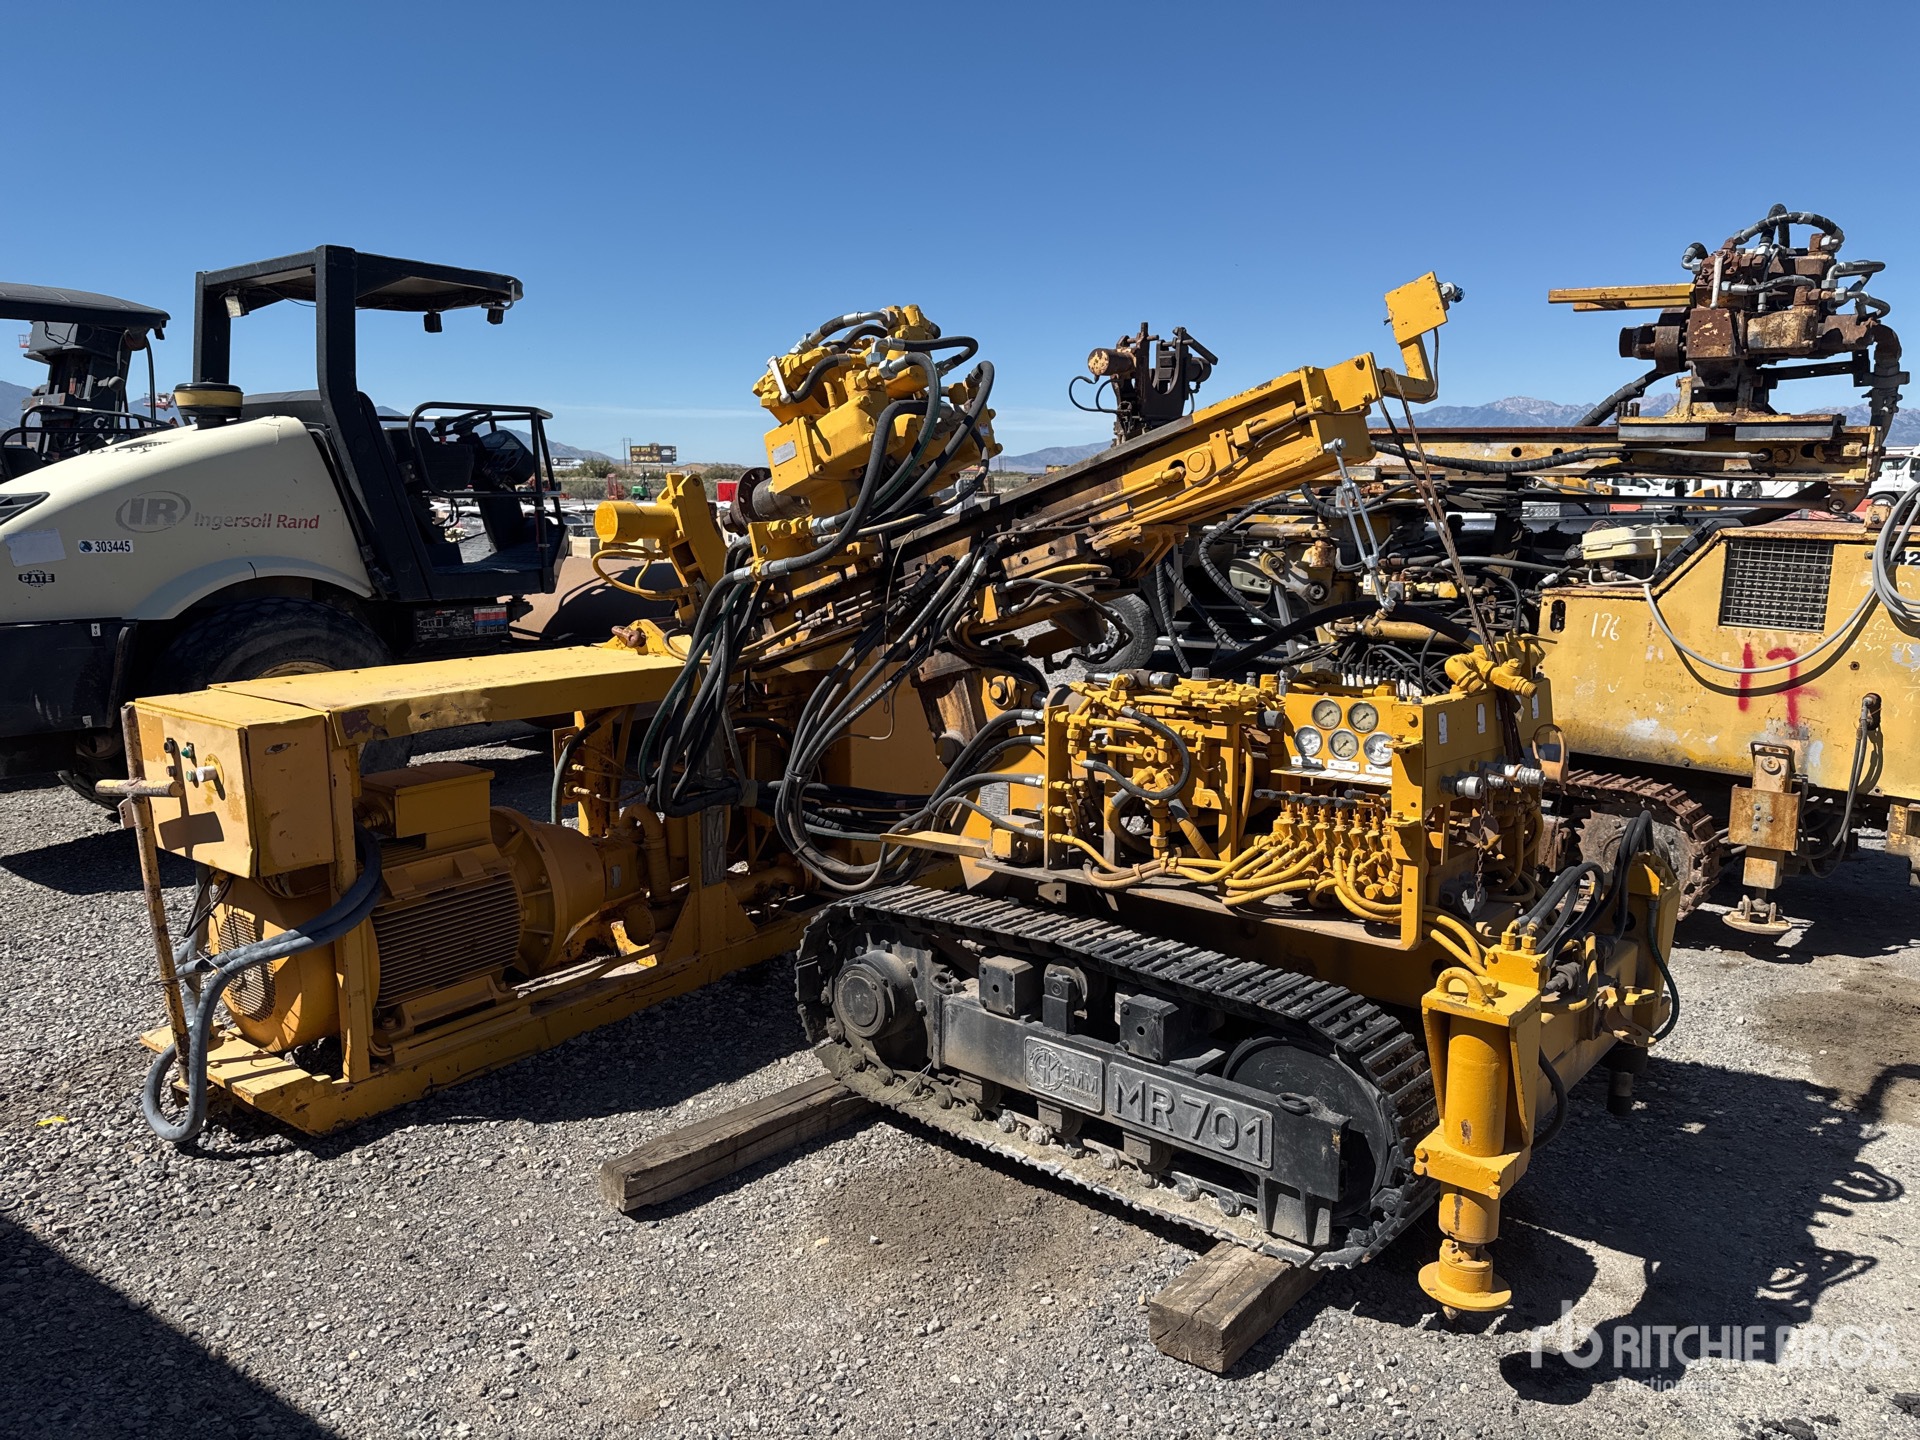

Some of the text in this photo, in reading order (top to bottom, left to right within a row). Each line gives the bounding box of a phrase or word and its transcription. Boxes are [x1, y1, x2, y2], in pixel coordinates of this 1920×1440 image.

[128, 498, 178, 526] IR
[193, 512, 320, 530] Ingersoll Rand
[95, 540, 131, 553] 303445
[20, 573, 54, 584] CATE
[1591, 612, 1620, 641] 176
